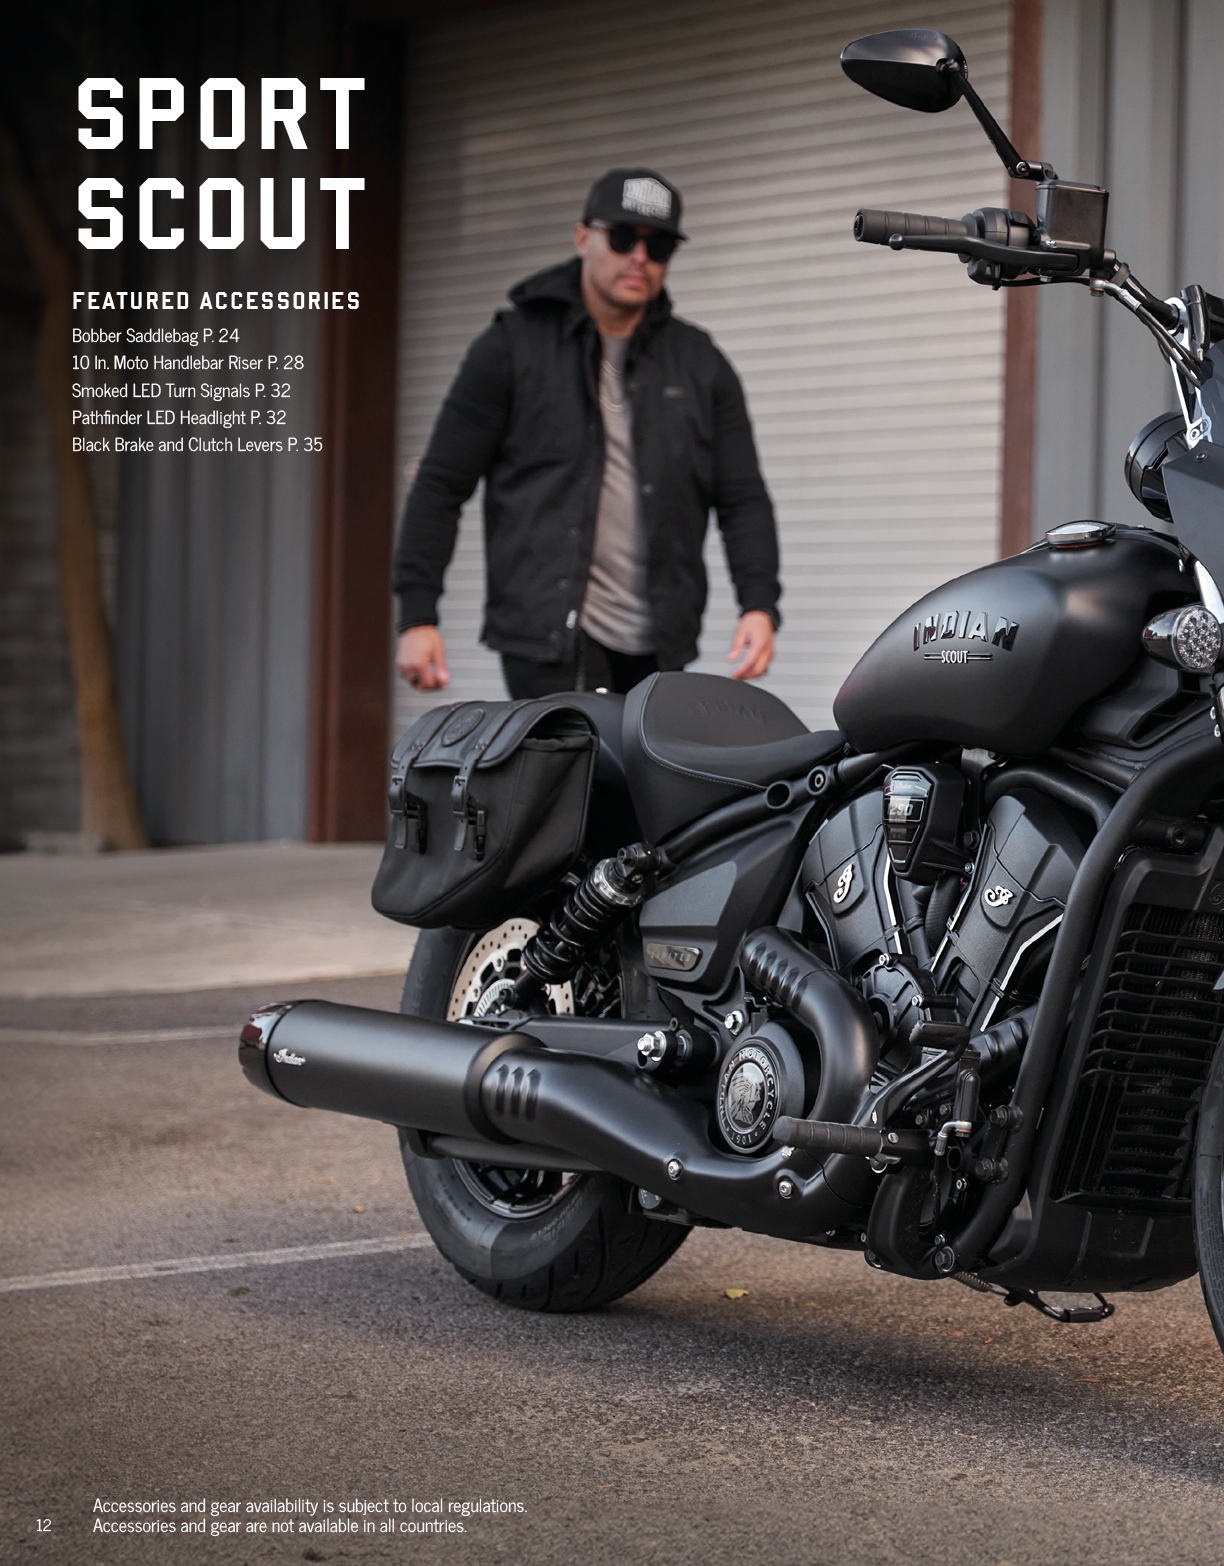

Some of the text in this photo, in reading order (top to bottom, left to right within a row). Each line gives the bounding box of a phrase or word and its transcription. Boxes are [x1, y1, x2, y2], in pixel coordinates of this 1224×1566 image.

[913, 610, 1019, 651] INDIAN
[941, 650, 968, 664] SCOUT
[731, 1131, 752, 1145] 1901
